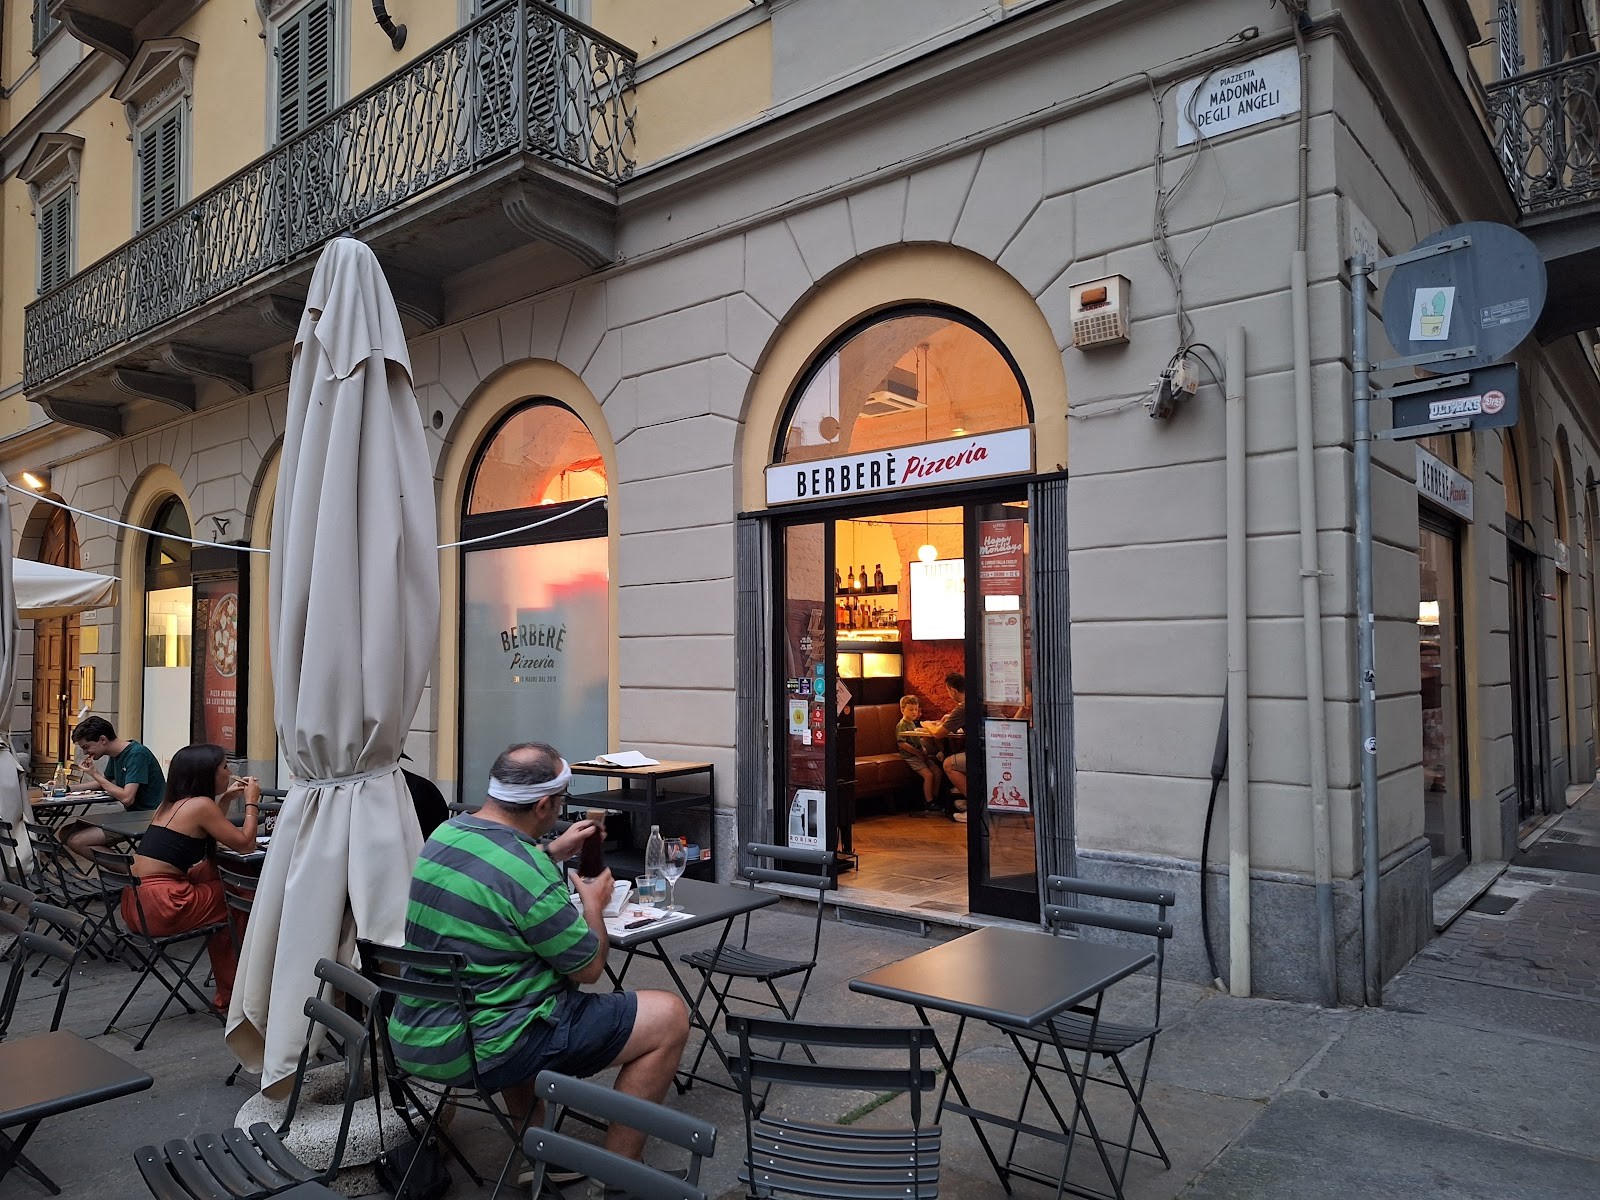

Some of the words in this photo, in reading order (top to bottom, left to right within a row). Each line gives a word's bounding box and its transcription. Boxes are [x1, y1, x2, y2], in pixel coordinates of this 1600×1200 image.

[1209, 78, 1267, 107] MADONNA
[1220, 70, 1255, 86] PIAZZETTA
[1198, 105, 1230, 127] DEGLI
[1237, 90, 1280, 116] ANGELI
[797, 453, 896, 497] BERBERÈ
[901, 442, 988, 484] Pizzeria
[984, 535, 1011, 546] Happy
[500, 622, 567, 653] BERBERÈ
[510, 652, 555, 669] Pizzeria
